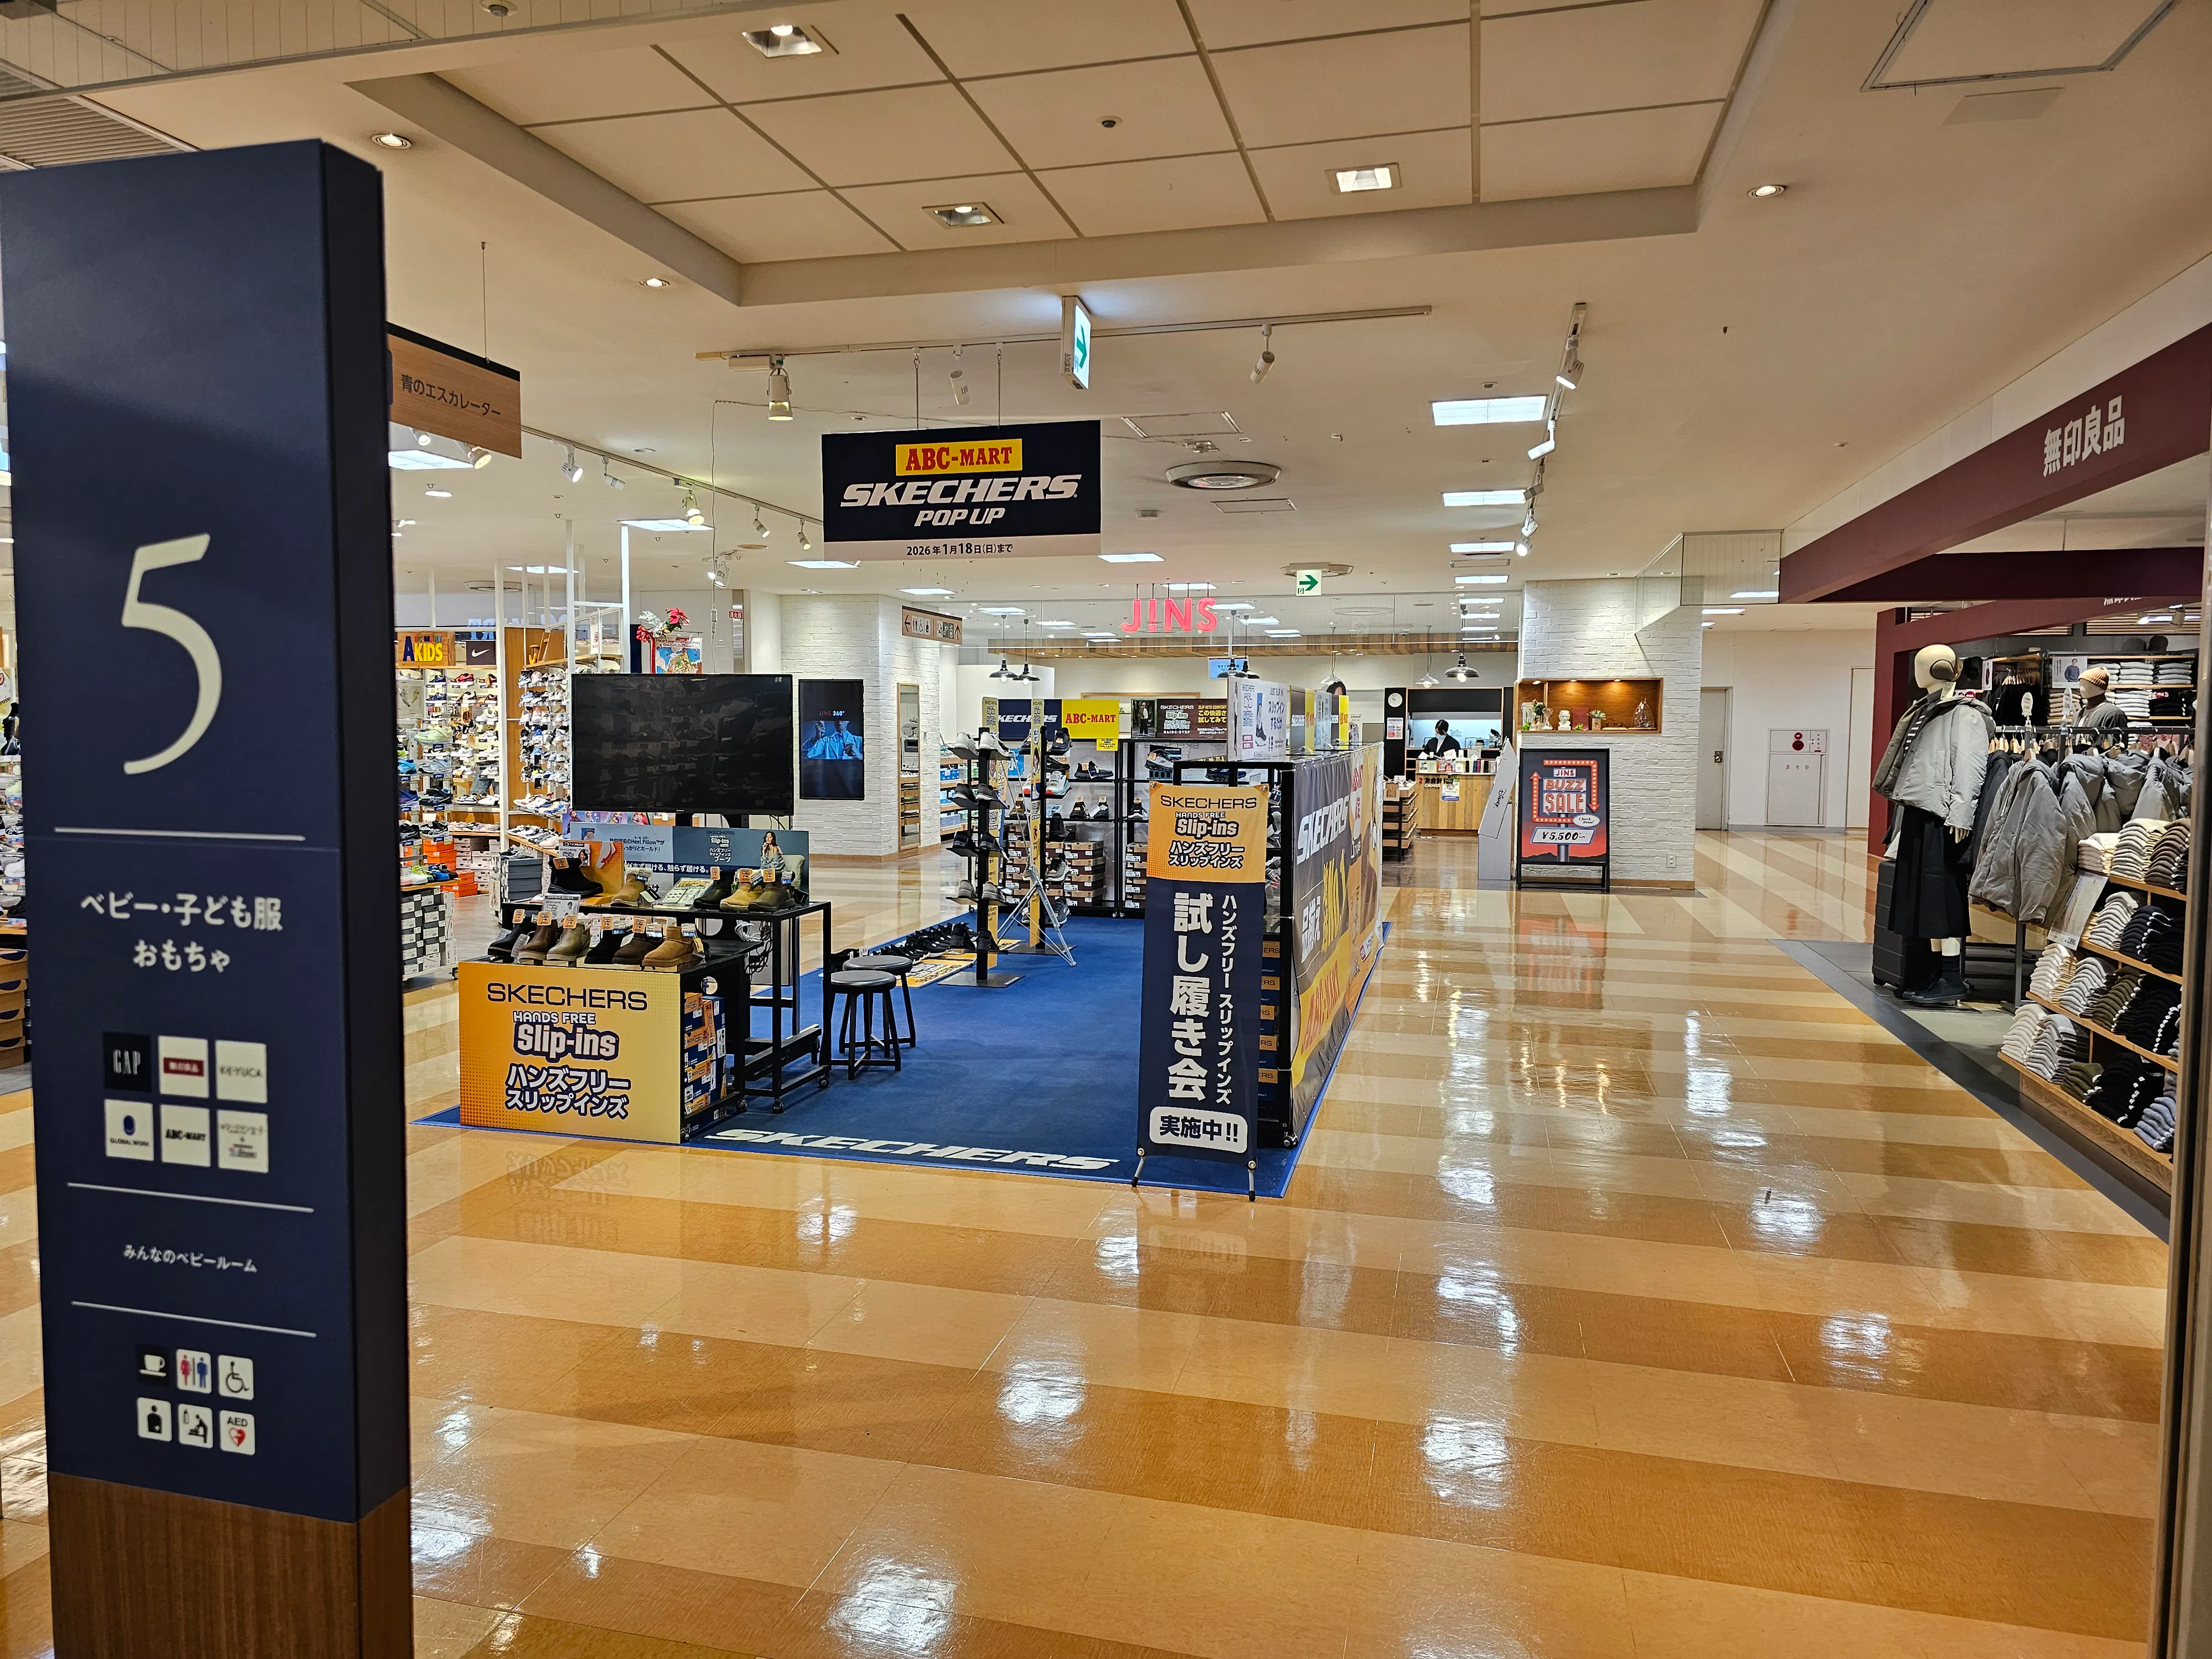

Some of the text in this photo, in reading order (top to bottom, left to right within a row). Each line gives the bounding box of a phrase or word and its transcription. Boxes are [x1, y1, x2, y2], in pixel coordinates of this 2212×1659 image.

[401, 374, 501, 415] 青のエスカレーター
[2043, 395, 2125, 477] 無印良品
[905, 446, 1013, 471] ABC-MART
[841, 474, 1082, 507] SKECHERS
[914, 508, 1006, 526] POP UP
[121, 533, 222, 775] 5
[415, 643, 443, 662] KIDS
[1065, 713, 1116, 724] ABC-MART
[1546, 780, 1584, 790] BUZZ
[1160, 795, 1257, 809] SKECHERS
[1545, 793, 1584, 813] SALE
[1177, 818, 1238, 838] Slip-ins
[1296, 795, 1350, 865] SKECHERS
[1168, 855, 1244, 869] スリップインズ
[1170, 841, 1245, 855] ハンズフリー
[80, 891, 283, 931] ベビー・子ども服
[133, 938, 231, 973] おもちゃ
[487, 982, 648, 1011] SKECHERS
[1167, 892, 1214, 1101] 試し履き会
[1216, 894, 1238, 1105] ハンズフリー スリップインズ
[513, 1011, 596, 1025] HANDS FREE
[517, 1024, 618, 1059] Slip-ins
[113, 1050, 141, 1076] GAP
[506, 1065, 630, 1093] ハンズフリー
[506, 1089, 629, 1118] スリップインズ
[165, 1129, 206, 1141] ABC-MART
[1159, 1114, 1239, 1143] 実施中!!
[704, 1129, 1120, 1171] SKECHERS
[123, 1244, 258, 1273] みんなのベビールーム
[227, 1416, 248, 1427] AED
